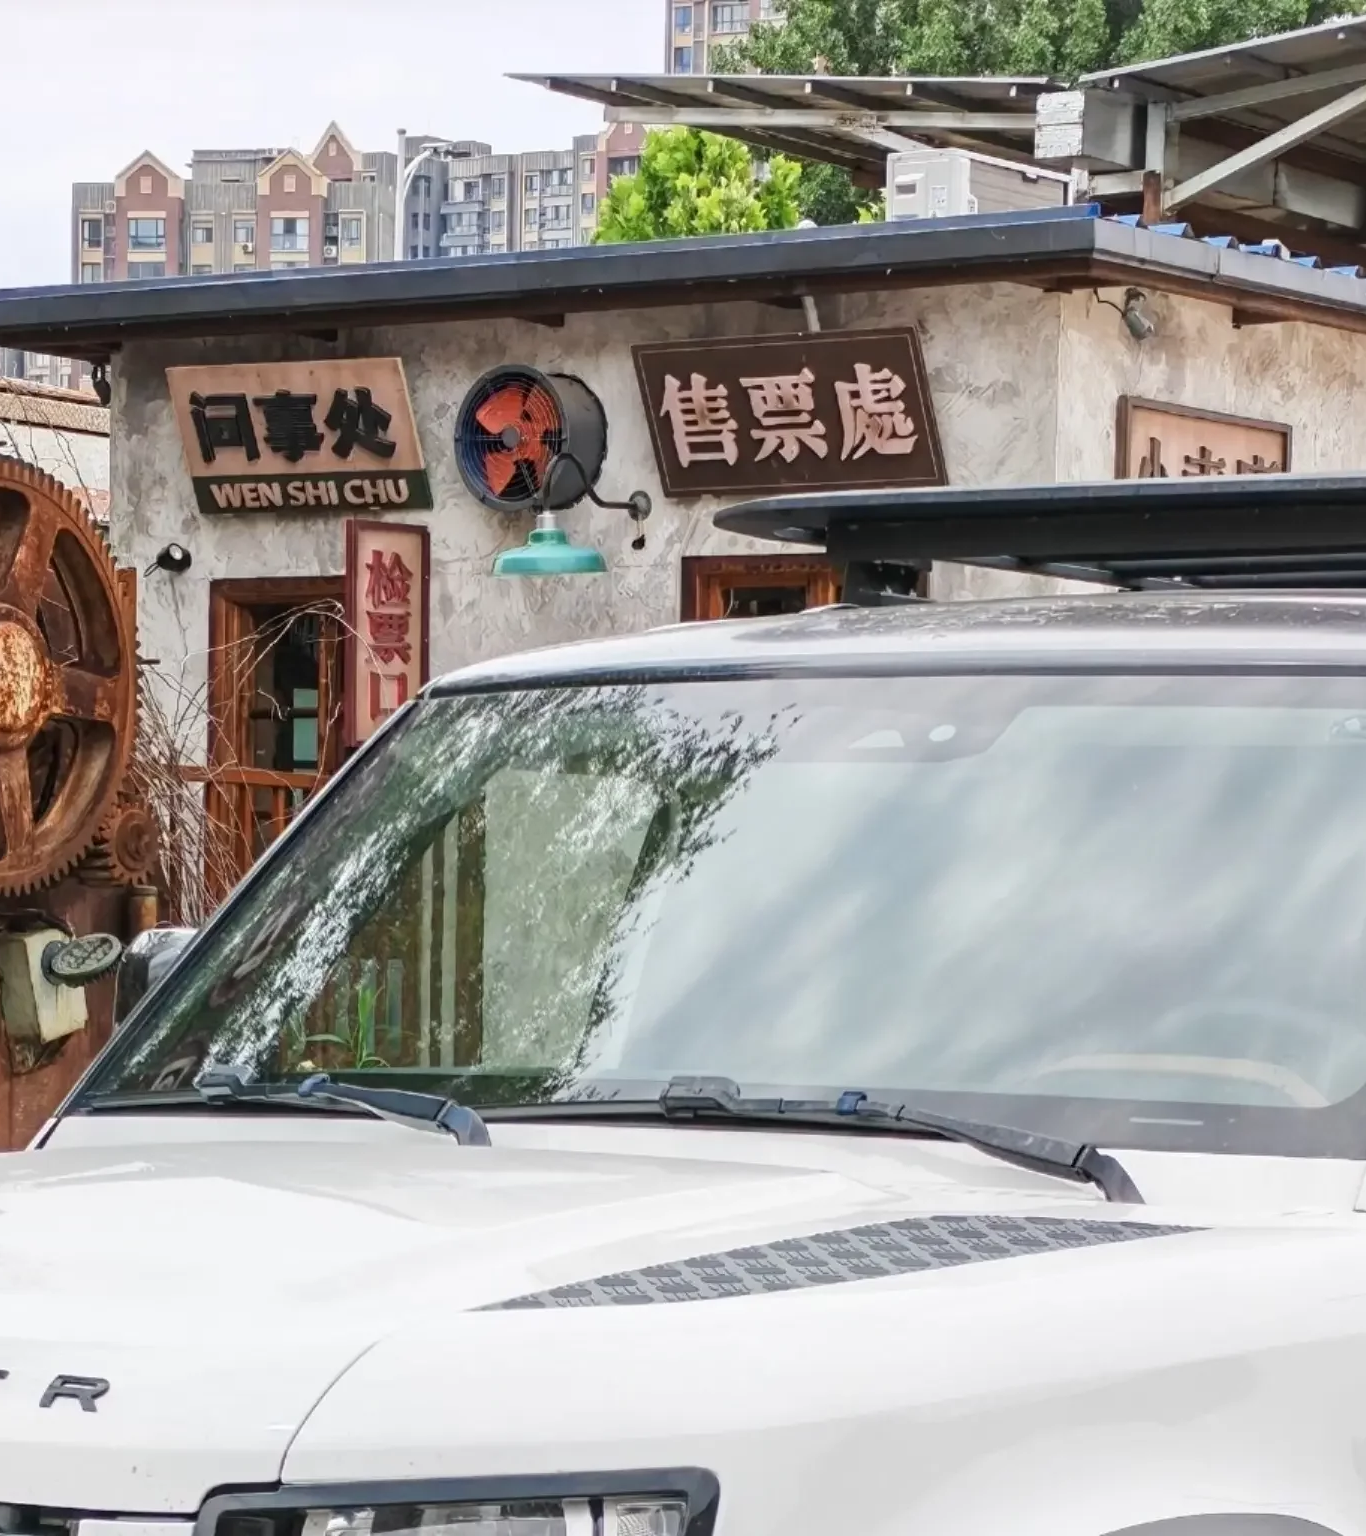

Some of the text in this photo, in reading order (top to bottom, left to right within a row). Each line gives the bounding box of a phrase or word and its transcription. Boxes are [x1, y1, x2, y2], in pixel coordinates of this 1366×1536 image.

[189, 385, 397, 464] 问事处
[659, 363, 919, 468] 售票處
[210, 477, 410, 509] WEN SHI CHU
